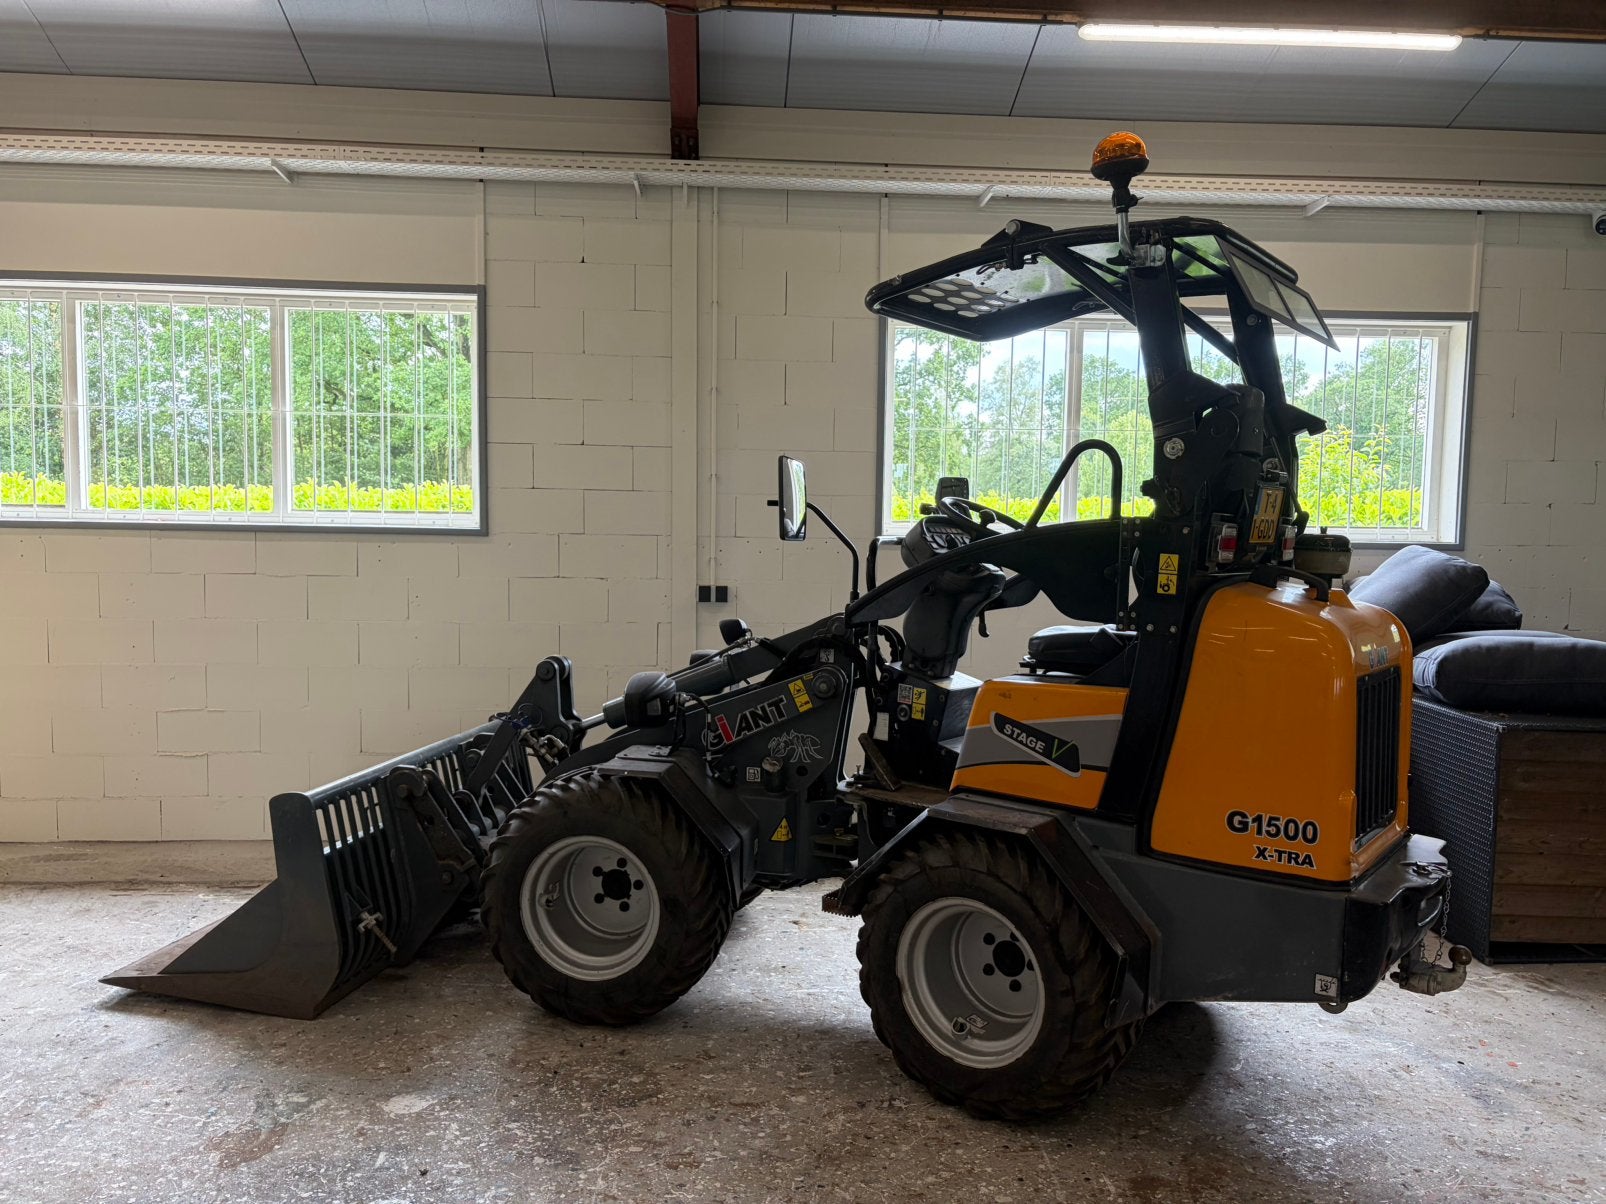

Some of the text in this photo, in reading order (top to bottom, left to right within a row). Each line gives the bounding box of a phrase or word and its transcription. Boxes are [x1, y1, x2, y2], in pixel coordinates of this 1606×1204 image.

[1003, 723, 1046, 753] STAGE
[1225, 809, 1319, 845] G1500
[1252, 844, 1316, 869] X-TRA
